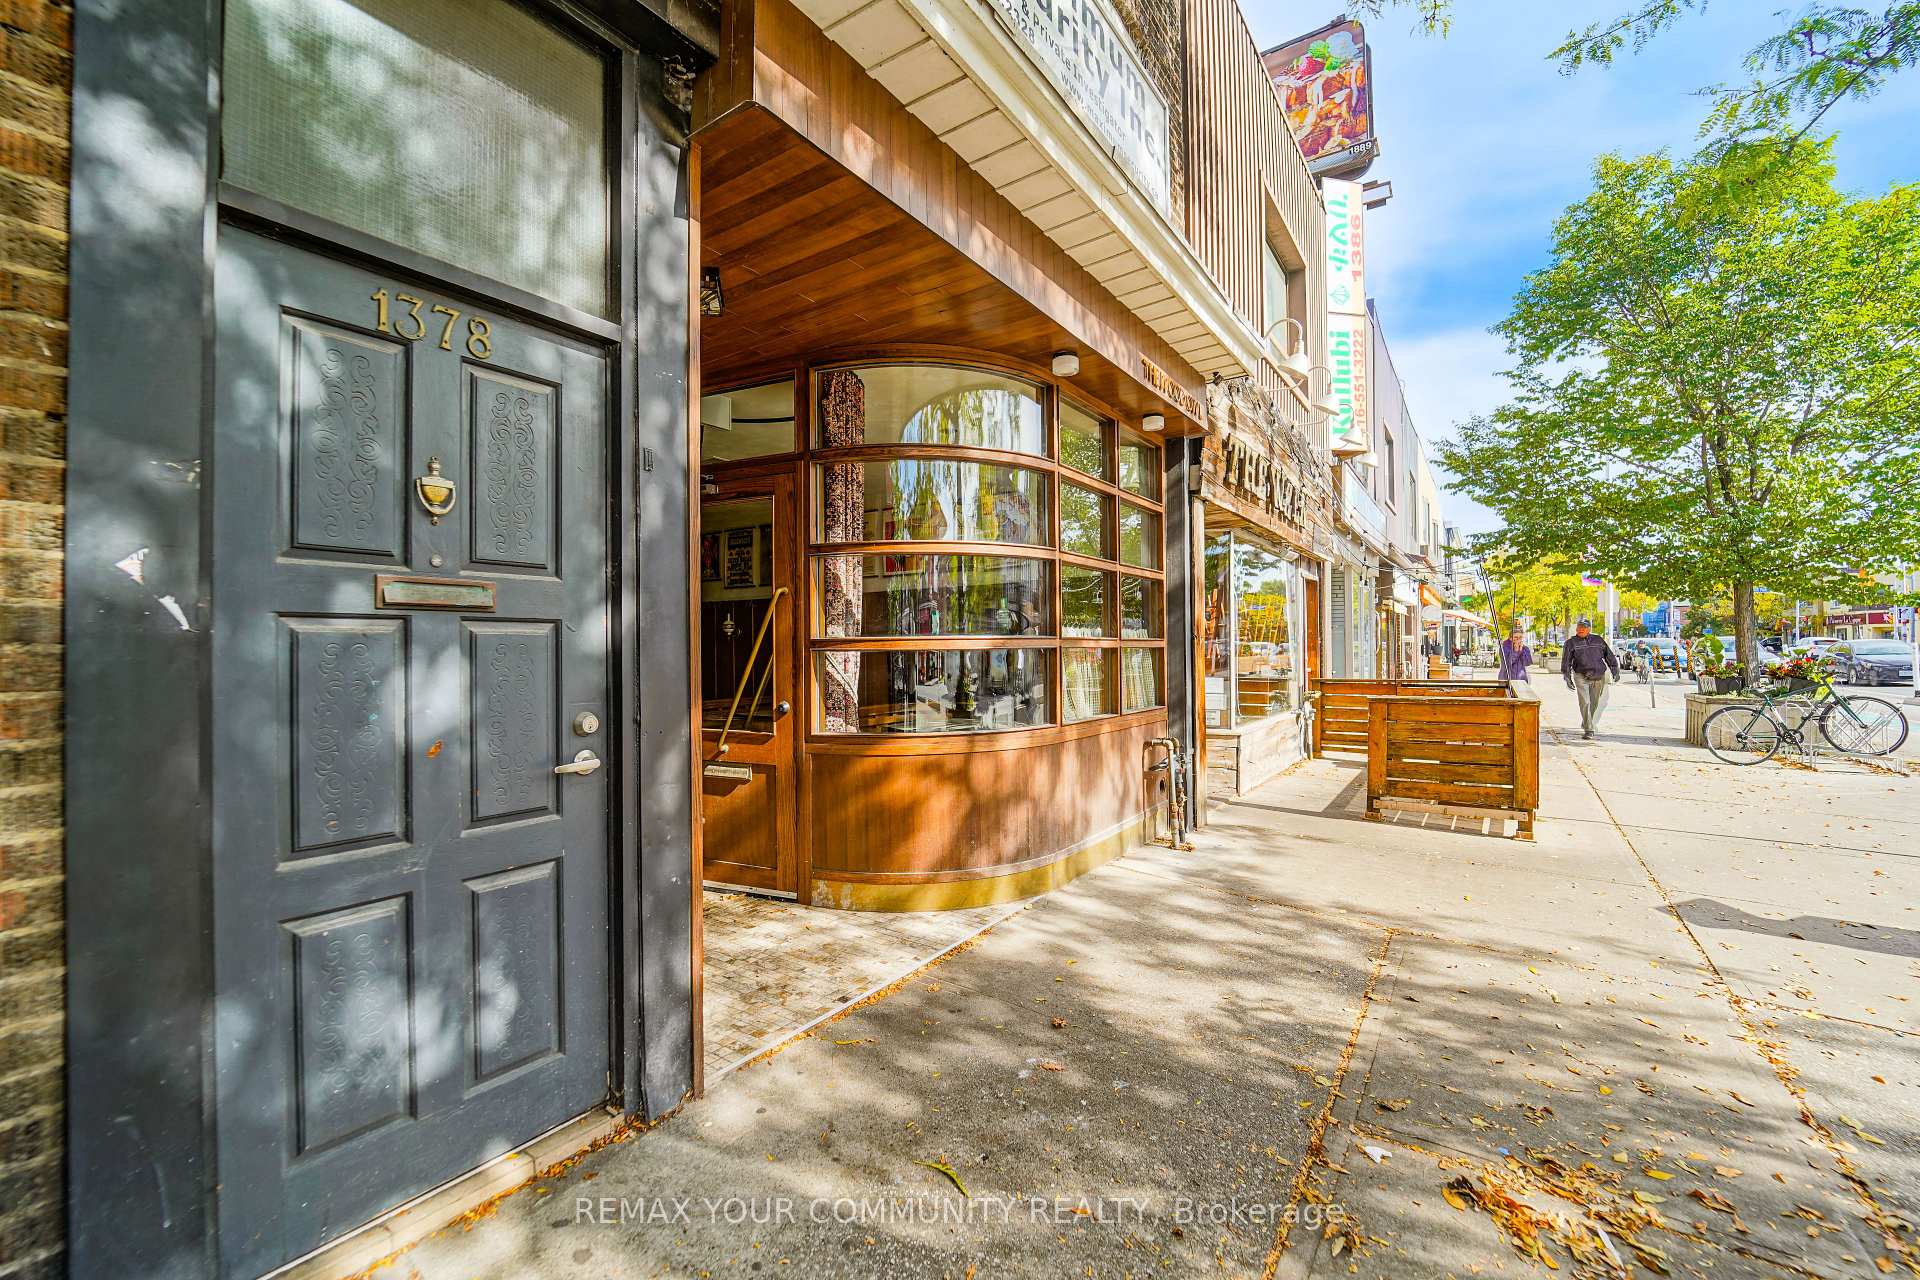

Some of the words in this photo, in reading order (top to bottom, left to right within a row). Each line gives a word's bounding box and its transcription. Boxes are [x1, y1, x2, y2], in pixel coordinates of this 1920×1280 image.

[1033, 12, 1071, 71] Private
[1073, 63, 1126, 141] Investigator
[1119, 84, 1161, 167] Inc.
[1349, 141, 1372, 155] 1889
[1350, 213, 1362, 282] 1386
[370, 287, 492, 360] 1378
